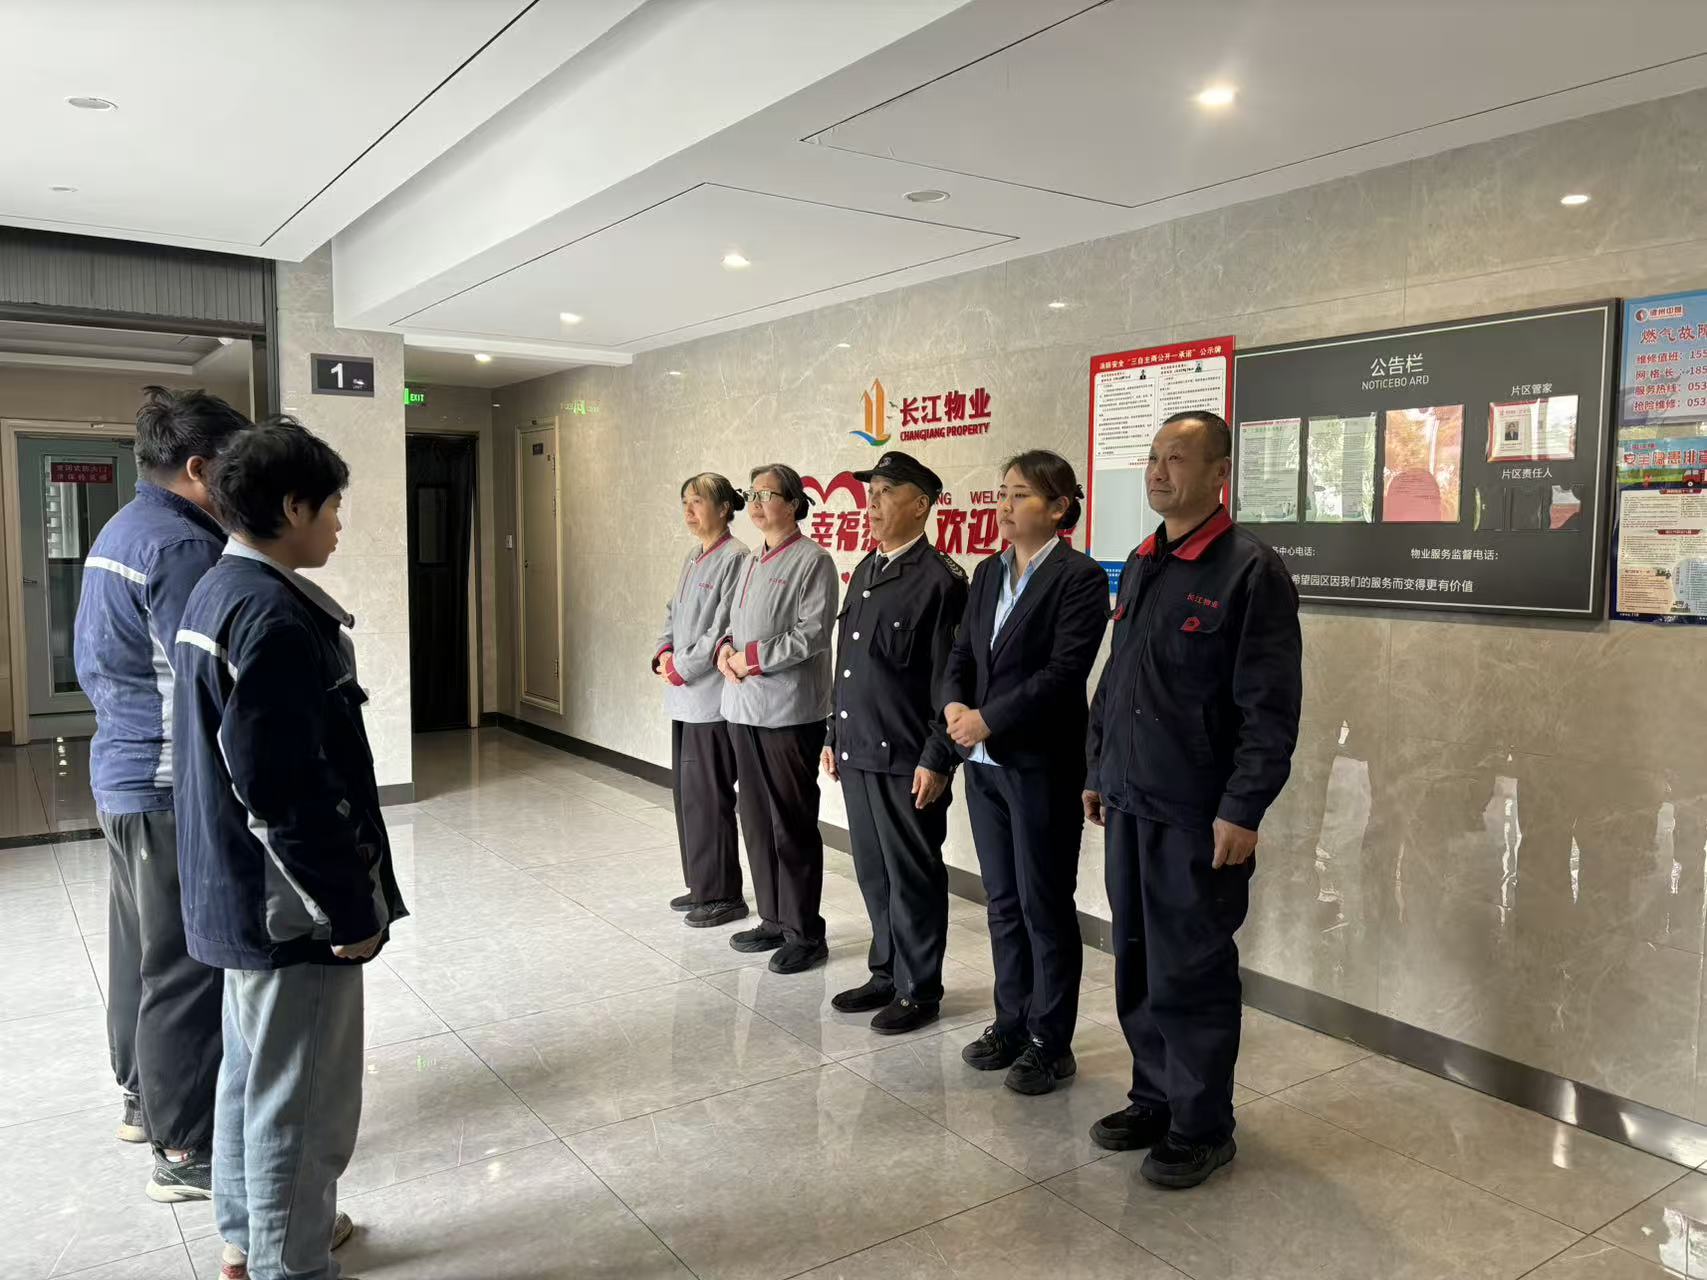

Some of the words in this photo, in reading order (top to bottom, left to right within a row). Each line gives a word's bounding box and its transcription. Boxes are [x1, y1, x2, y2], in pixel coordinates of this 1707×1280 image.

[1370, 352, 1424, 377] 公告栏
[331, 362, 343, 389] 1
[410, 393, 424, 402] EXIT
[1510, 382, 1553, 397] 片区管家
[899, 387, 992, 428] 长江物业
[900, 427, 946, 442] CHANGJIANG
[946, 422, 991, 438] PROPERTY
[1501, 467, 1553, 480] 片区责任人
[1410, 547, 1499, 561] 物业服务监督电话：
[1291, 573, 1474, 593] 希望园区因我们的服务而变得更有价值
